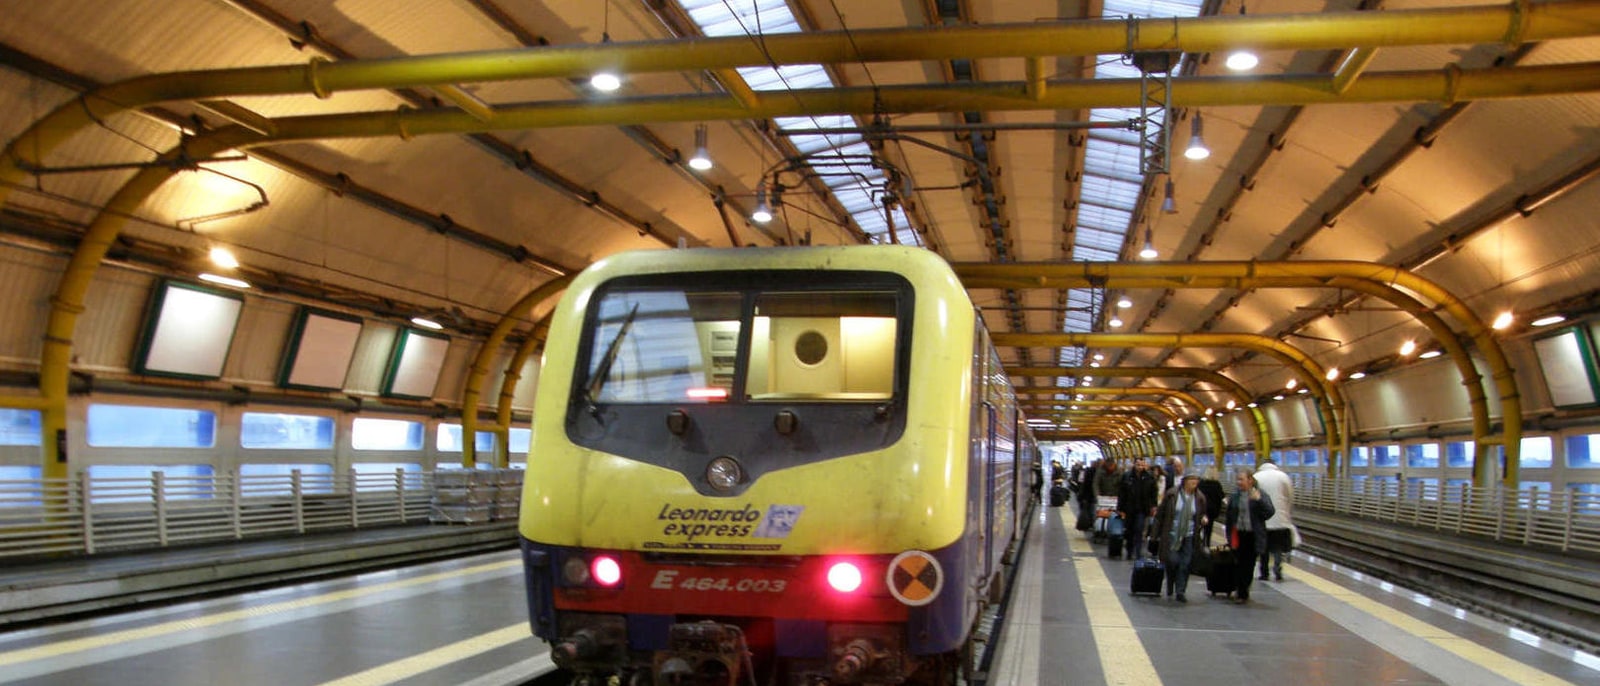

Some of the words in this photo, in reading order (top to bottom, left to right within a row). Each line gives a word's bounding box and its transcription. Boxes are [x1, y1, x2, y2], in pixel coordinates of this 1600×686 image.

[658, 503, 760, 522] Leonardo
[664, 521, 752, 541] express
[652, 570, 678, 589] E
[680, 578, 786, 592] 464.003
